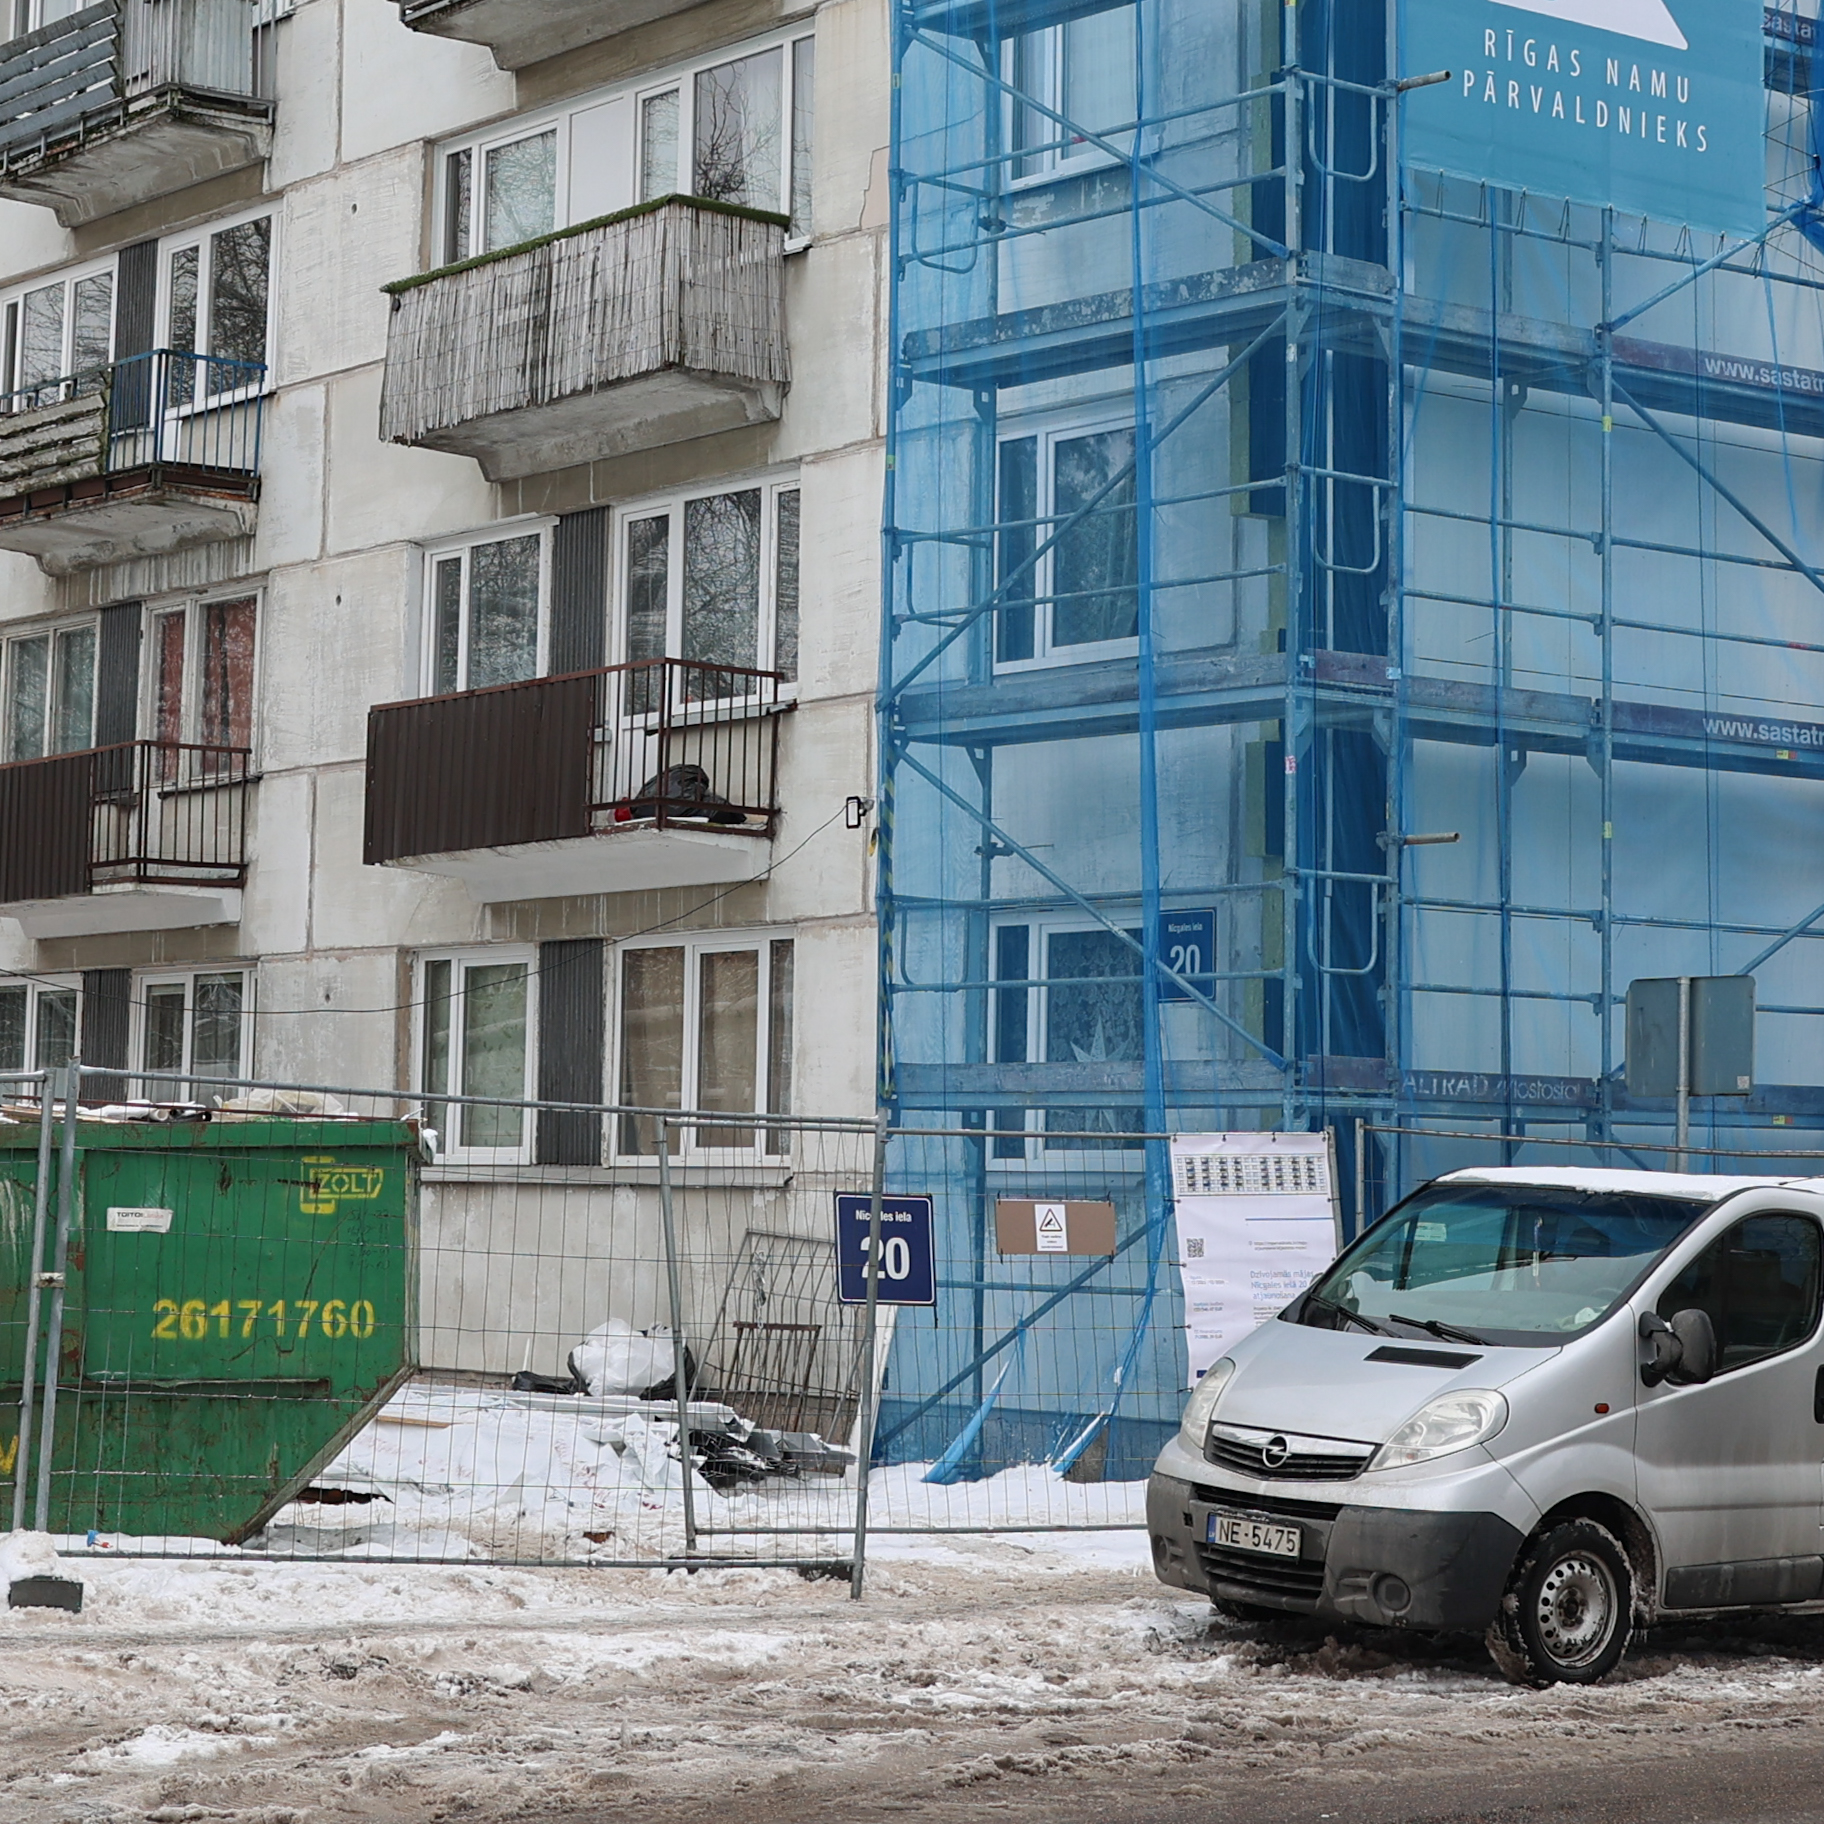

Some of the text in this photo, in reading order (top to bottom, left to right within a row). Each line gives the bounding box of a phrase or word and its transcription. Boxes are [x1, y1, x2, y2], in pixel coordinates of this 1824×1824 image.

[1484, 28, 1689, 104] RĪGAS NAMU
[1463, 69, 1708, 152] PĀRVALDNIEKS
[1170, 944, 1201, 974] 20
[1402, 1074, 1488, 1097] ALTRAD
[317, 1173, 377, 1193] ZOLT
[855, 1209, 913, 1222] Nīcles iela
[860, 1236, 911, 1280] 20
[151, 1298, 375, 1339] 26171760
[1219, 1519, 1297, 1552] NE-5475
